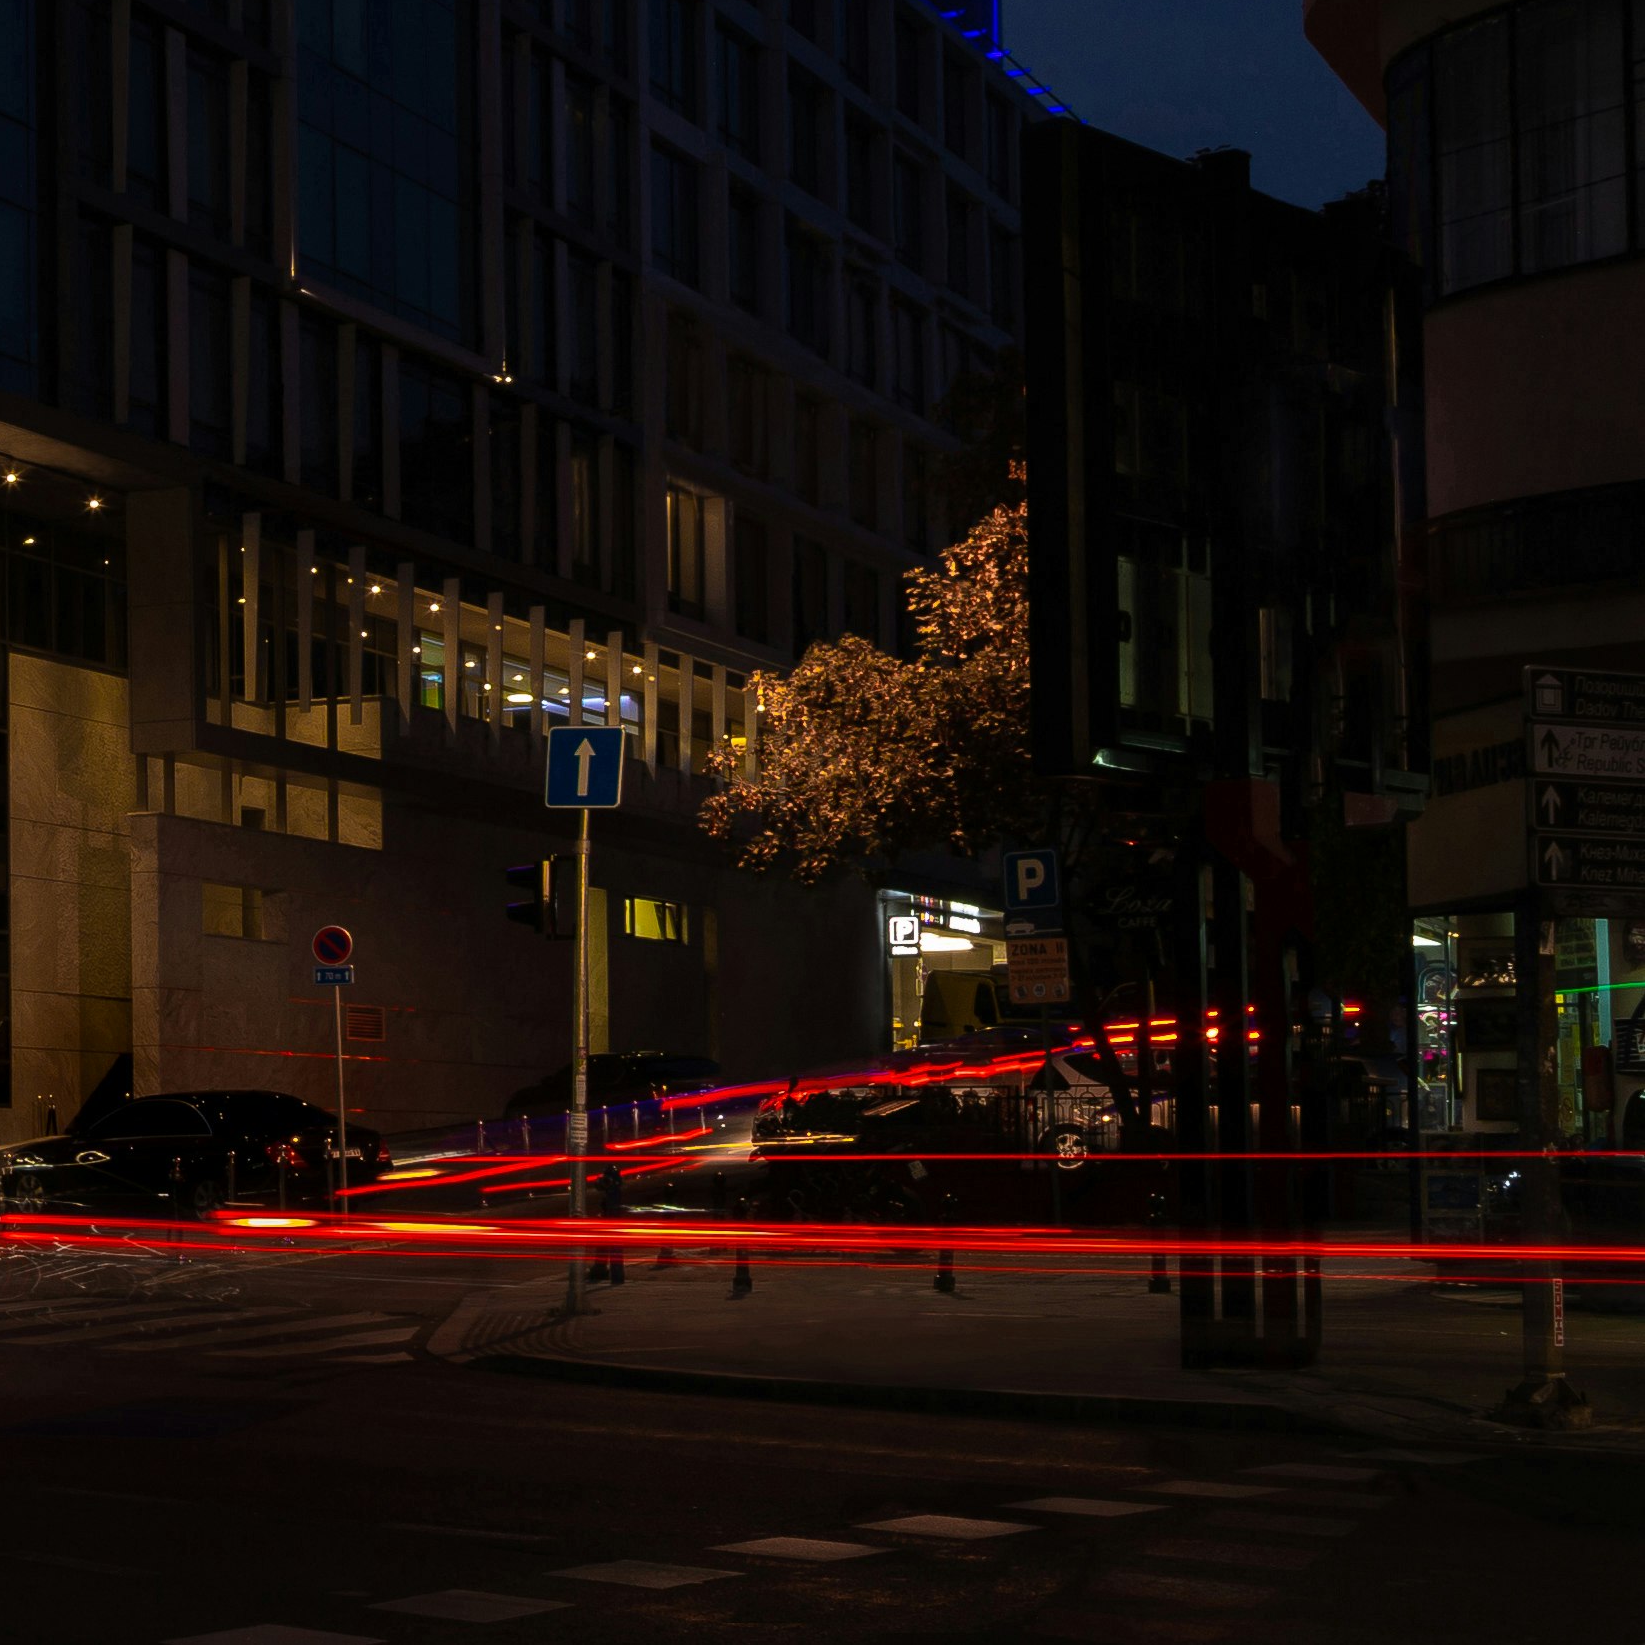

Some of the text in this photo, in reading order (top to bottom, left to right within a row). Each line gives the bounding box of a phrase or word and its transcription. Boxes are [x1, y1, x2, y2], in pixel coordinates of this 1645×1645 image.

[1577, 753, 1632, 774] Republic
[1578, 808, 1645, 833] Kalemegd
[1581, 864, 1613, 883] Knez
[1011, 943, 1047, 956] ZONA
